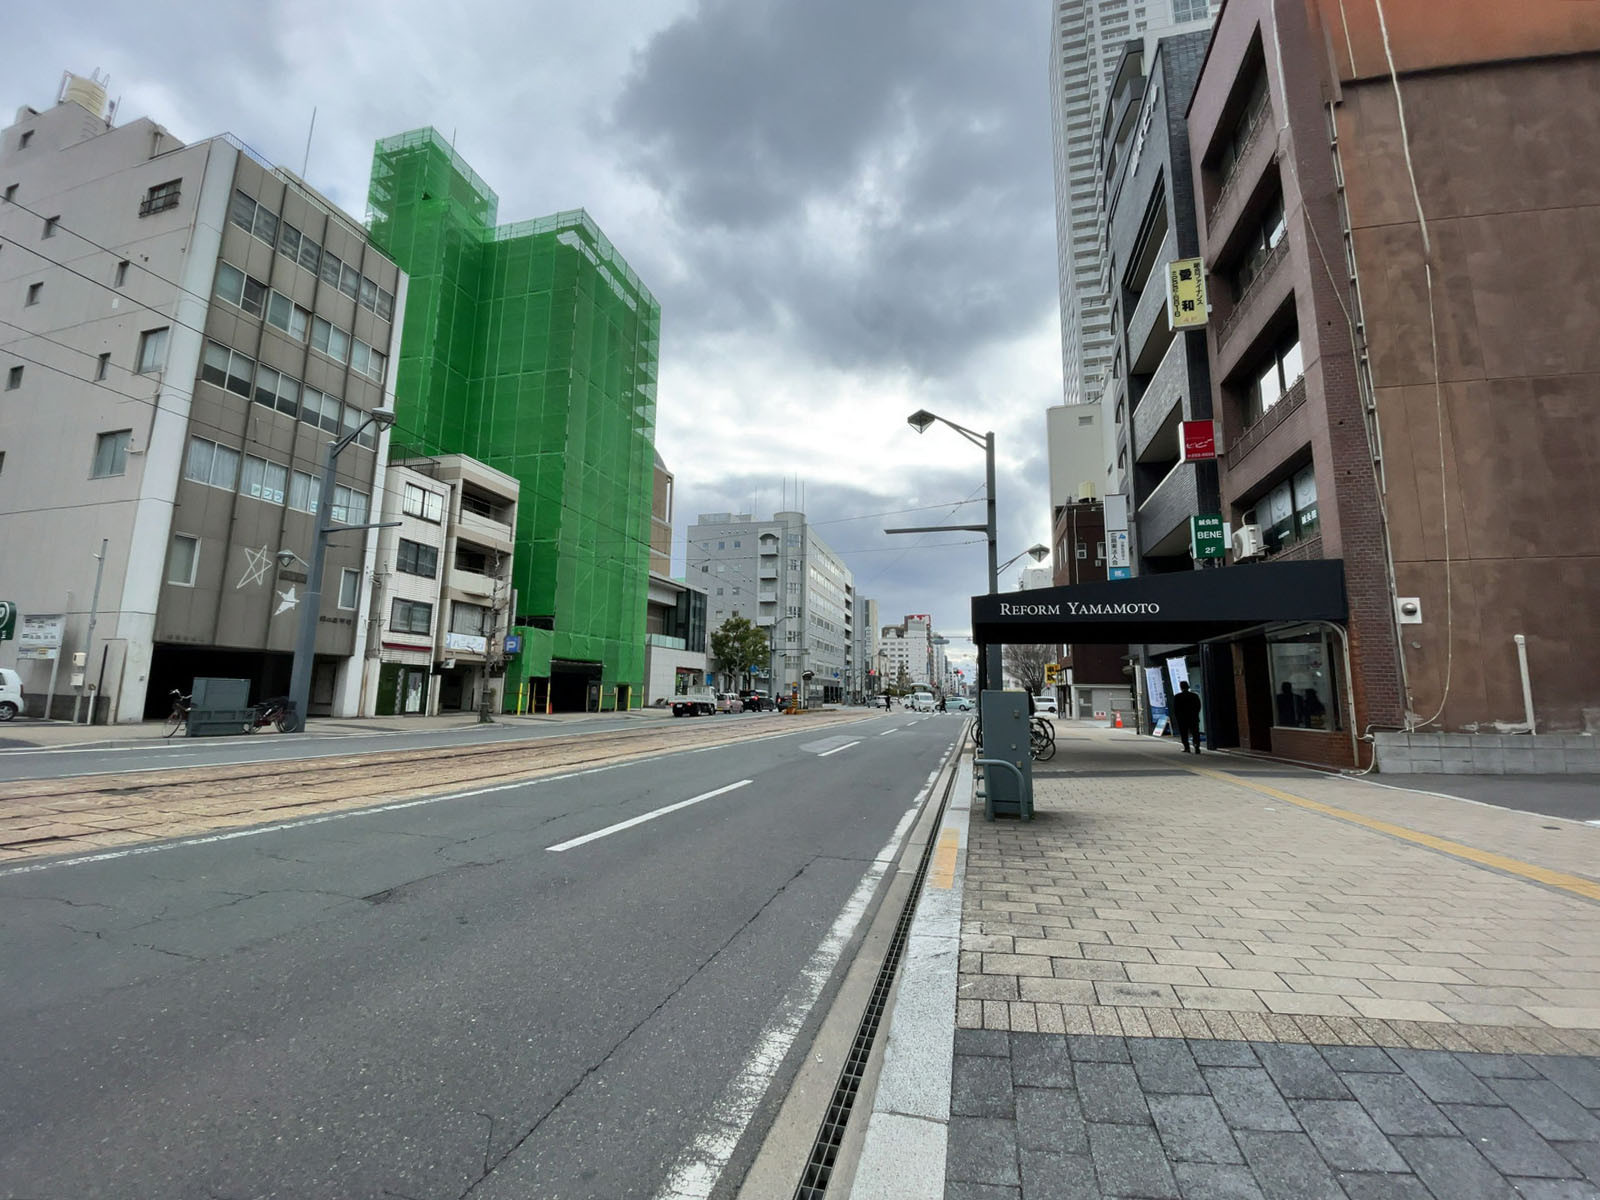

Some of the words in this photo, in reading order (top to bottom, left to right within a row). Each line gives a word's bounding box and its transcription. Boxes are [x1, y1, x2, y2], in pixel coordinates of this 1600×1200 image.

[1197, 530, 1223, 540] BENE
[1204, 546, 1217, 554] 2F
[506, 641, 517, 651] P
